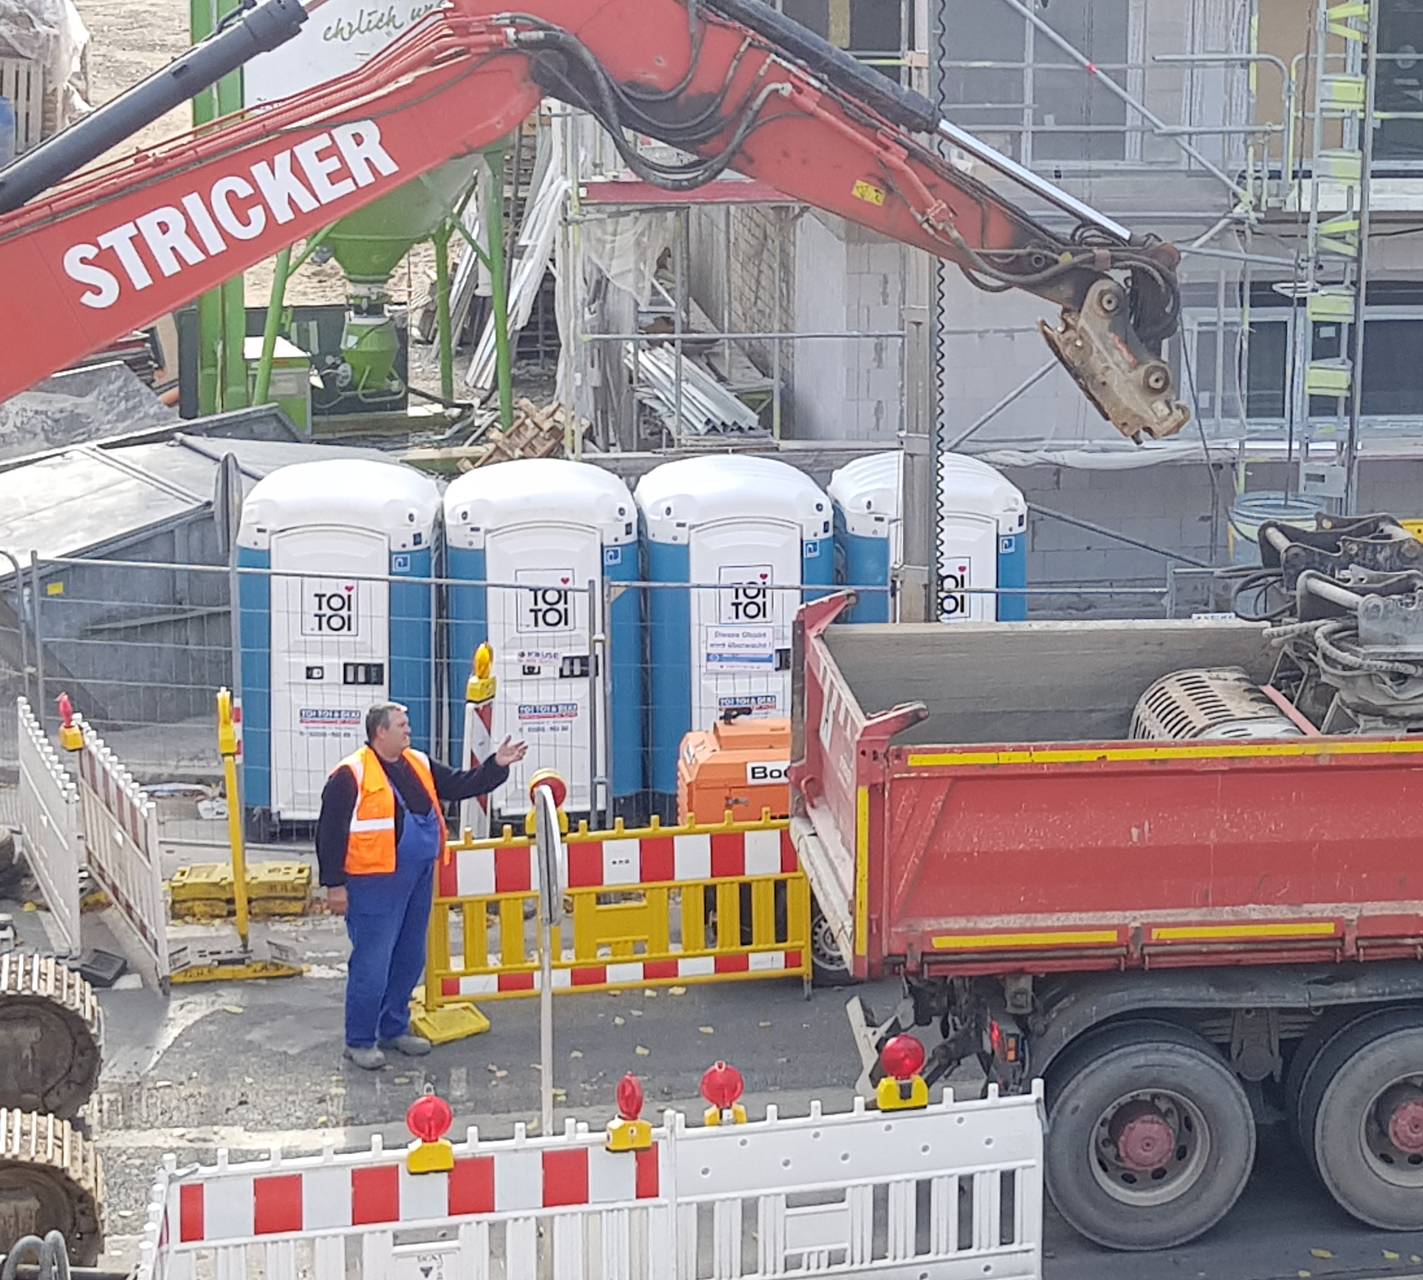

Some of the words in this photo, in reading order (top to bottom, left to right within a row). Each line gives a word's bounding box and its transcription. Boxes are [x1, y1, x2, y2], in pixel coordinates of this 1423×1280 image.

[323, 6, 404, 41] ehrlich
[63, 118, 400, 309] STRICKER
[529, 587, 568, 606] TOI
[732, 580, 767, 600] TOI
[313, 593, 352, 612] TOI
[732, 601, 767, 620] TOI
[313, 613, 352, 631] TOI
[529, 607, 568, 627] TOI
[751, 765, 789, 780] Bo
